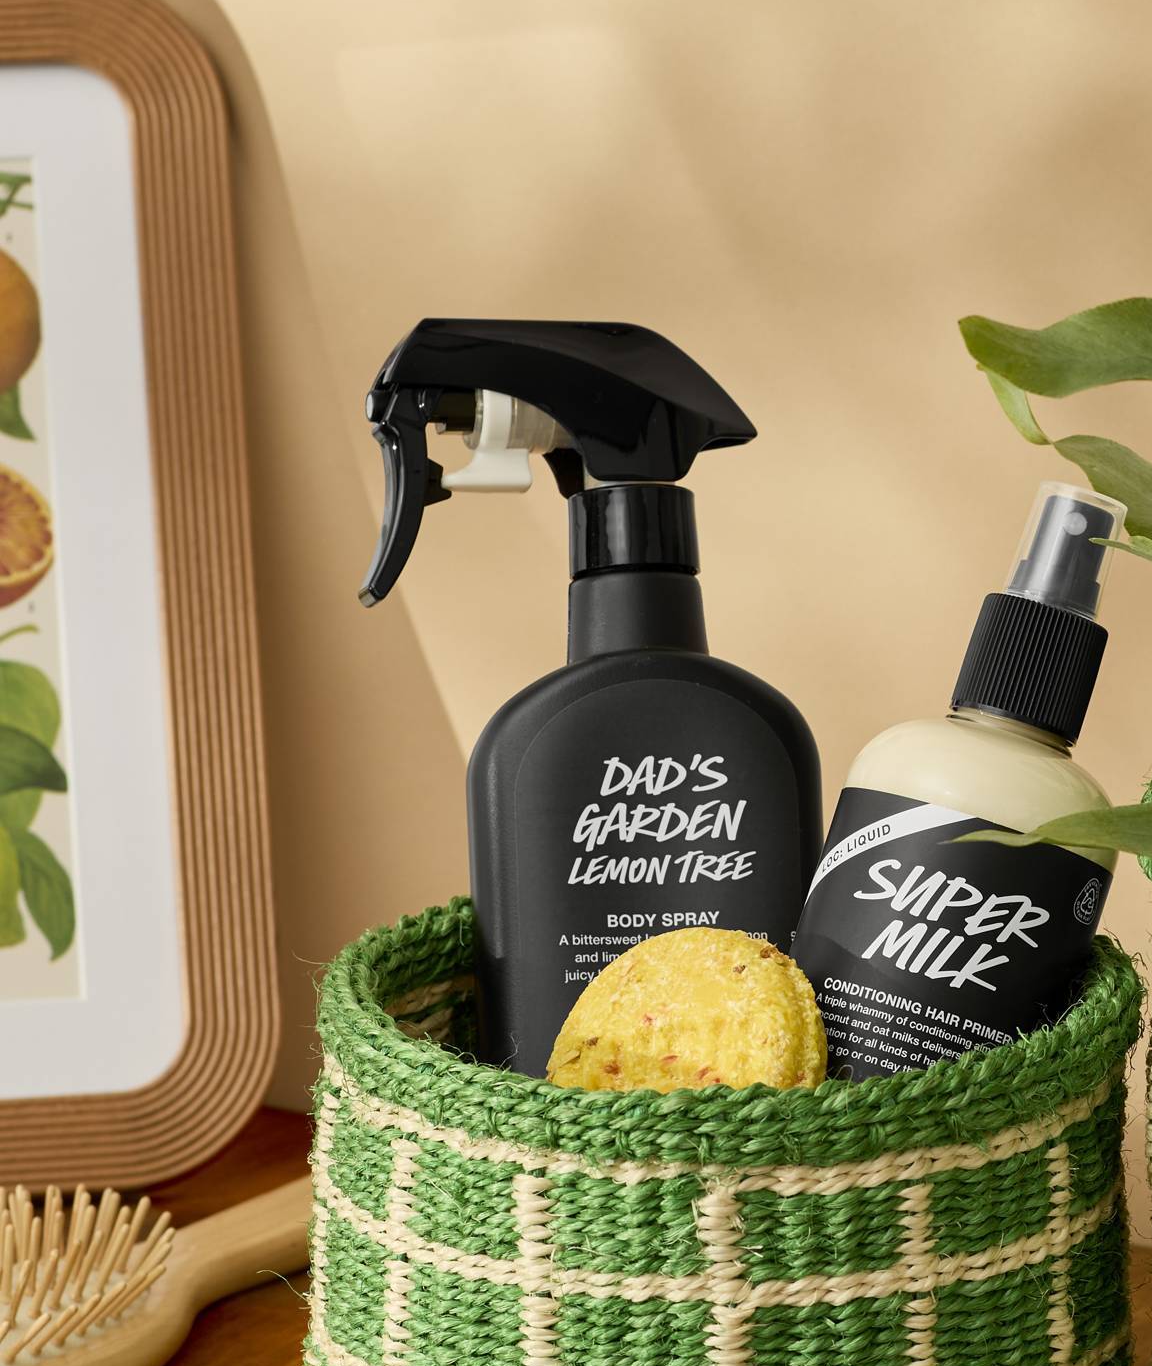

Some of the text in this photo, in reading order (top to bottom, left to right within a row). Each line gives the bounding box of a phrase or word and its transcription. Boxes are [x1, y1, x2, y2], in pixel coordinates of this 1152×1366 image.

[600, 754, 728, 797] DAD'S
[572, 799, 747, 852] GARDEN
[567, 850, 757, 886] LEMON TREE
[822, 824, 891, 873] LOC: LIQUID
[607, 911, 720, 928] BODY SPRAY
[853, 859, 1050, 948] SUPER
[559, 935, 569, 946] A
[572, 934, 641, 946] bittersweet
[575, 952, 599, 963] and
[861, 920, 1010, 992] MILK
[564, 969, 595, 984] juicy
[816, 992, 823, 1003] A
[824, 995, 847, 1009] triple
[849, 1002, 894, 1024] whammy
[896, 1016, 909, 1026] of
[909, 1021, 972, 1050] conditioning
[824, 977, 1012, 1045] CONDITIONING HAIR PRIMER
[836, 1046, 849, 1057] go
[851, 1051, 863, 1060] or
[864, 1055, 878, 1065] on
[880, 1058, 900, 1073] day
[848, 1032, 863, 1044] for
[864, 1038, 878, 1049] all
[879, 1041, 908, 1058] kinds
[910, 1052, 922, 1062] of
[851, 1019, 871, 1031] and
[872, 1025, 890, 1037] oat
[891, 1030, 920, 1046] milks
[922, 1040, 961, 1061] delivers
